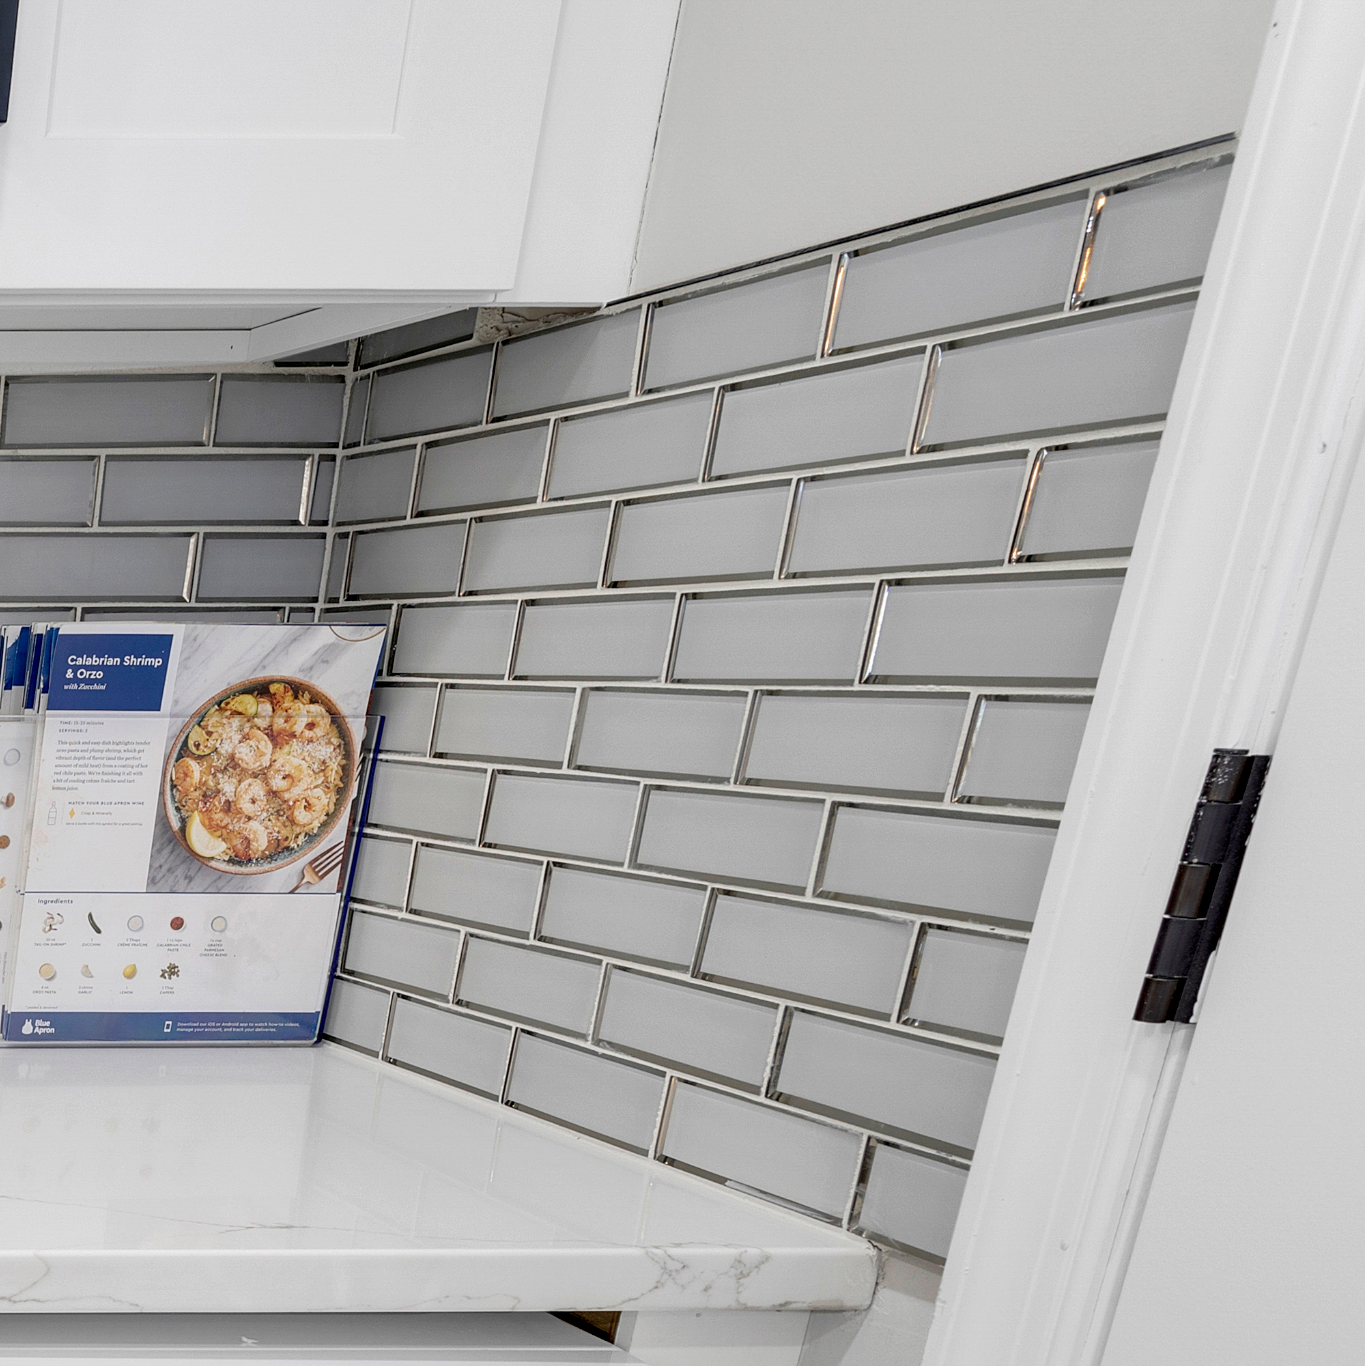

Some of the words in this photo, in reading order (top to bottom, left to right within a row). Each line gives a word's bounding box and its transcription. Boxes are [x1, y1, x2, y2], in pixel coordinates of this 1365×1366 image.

[68, 654, 120, 665] Calabrian
[123, 655, 162, 667] Shrimp
[66, 669, 74, 678] &
[77, 669, 103, 678] Orzo
[34, 1027, 55, 1035] Apron
